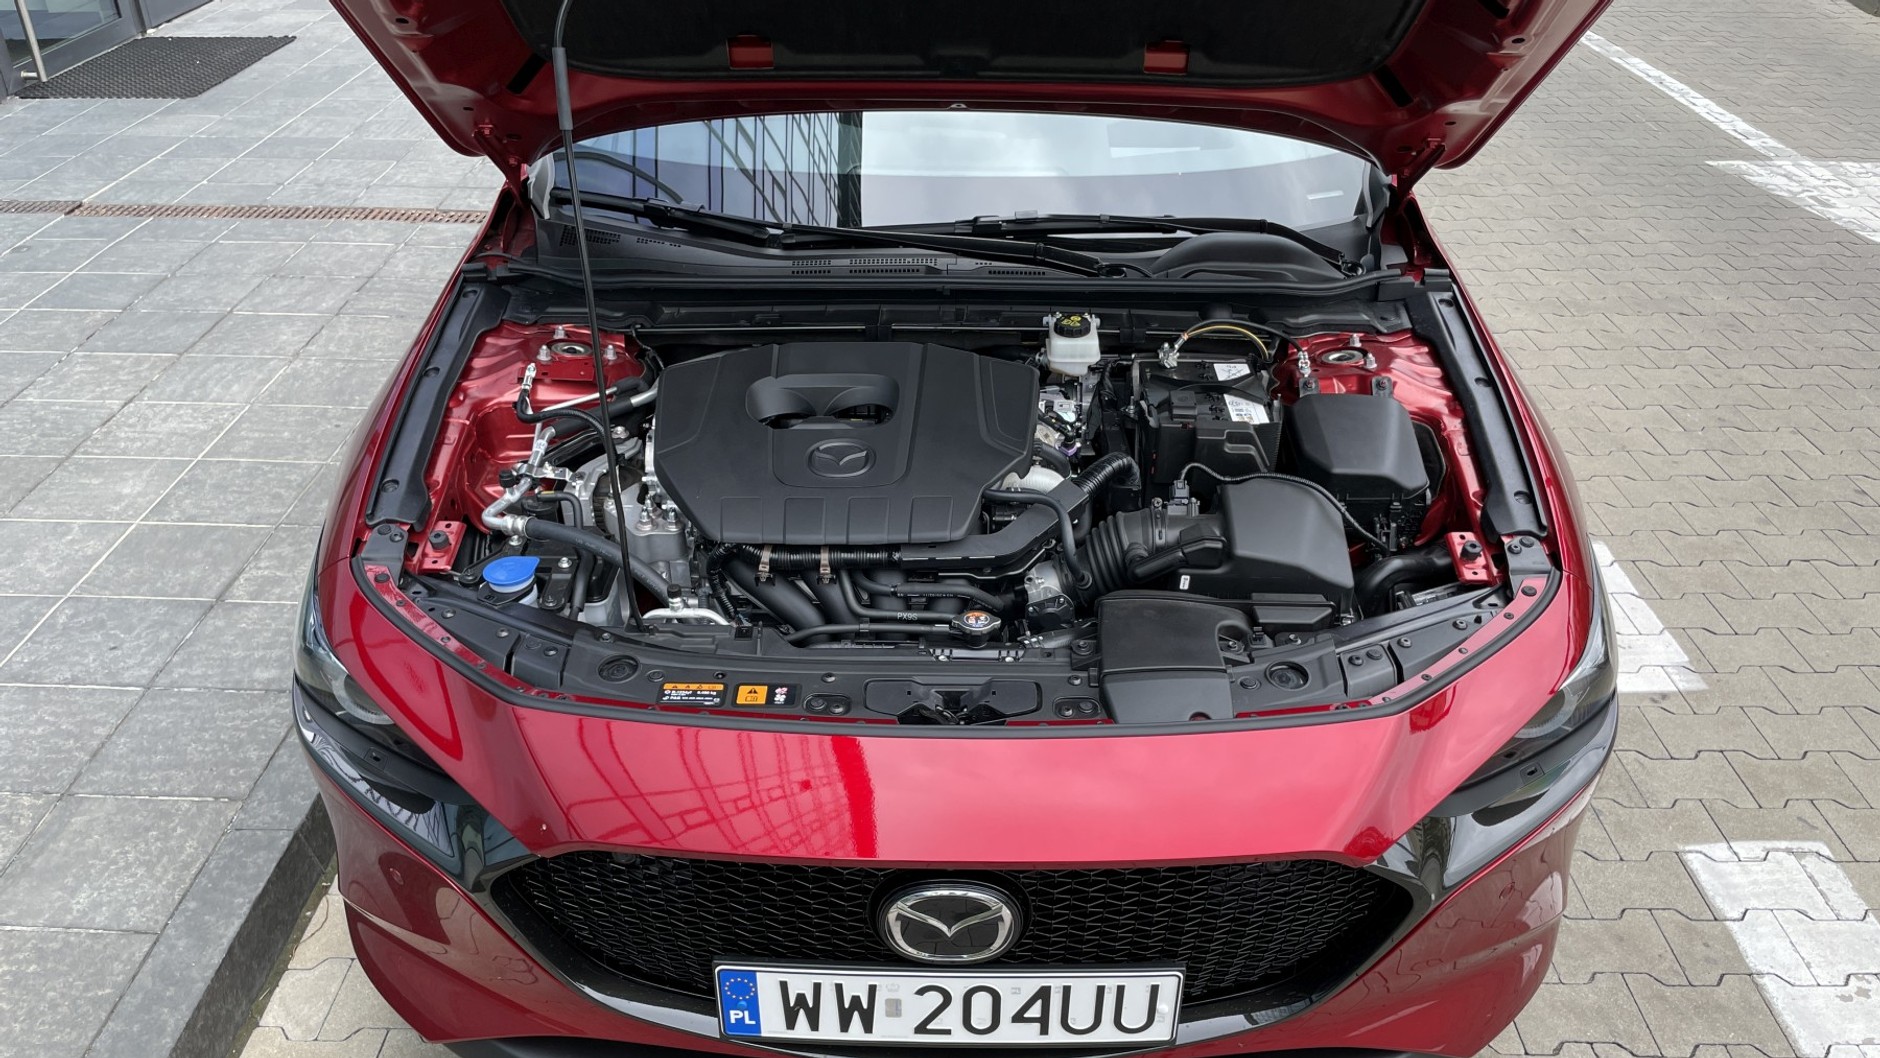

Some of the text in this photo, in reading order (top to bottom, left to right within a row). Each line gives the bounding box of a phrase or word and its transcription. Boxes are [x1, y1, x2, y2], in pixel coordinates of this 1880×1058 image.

[729, 1010, 756, 1024] PL
[779, 980, 1160, 1036] WW 204UU
